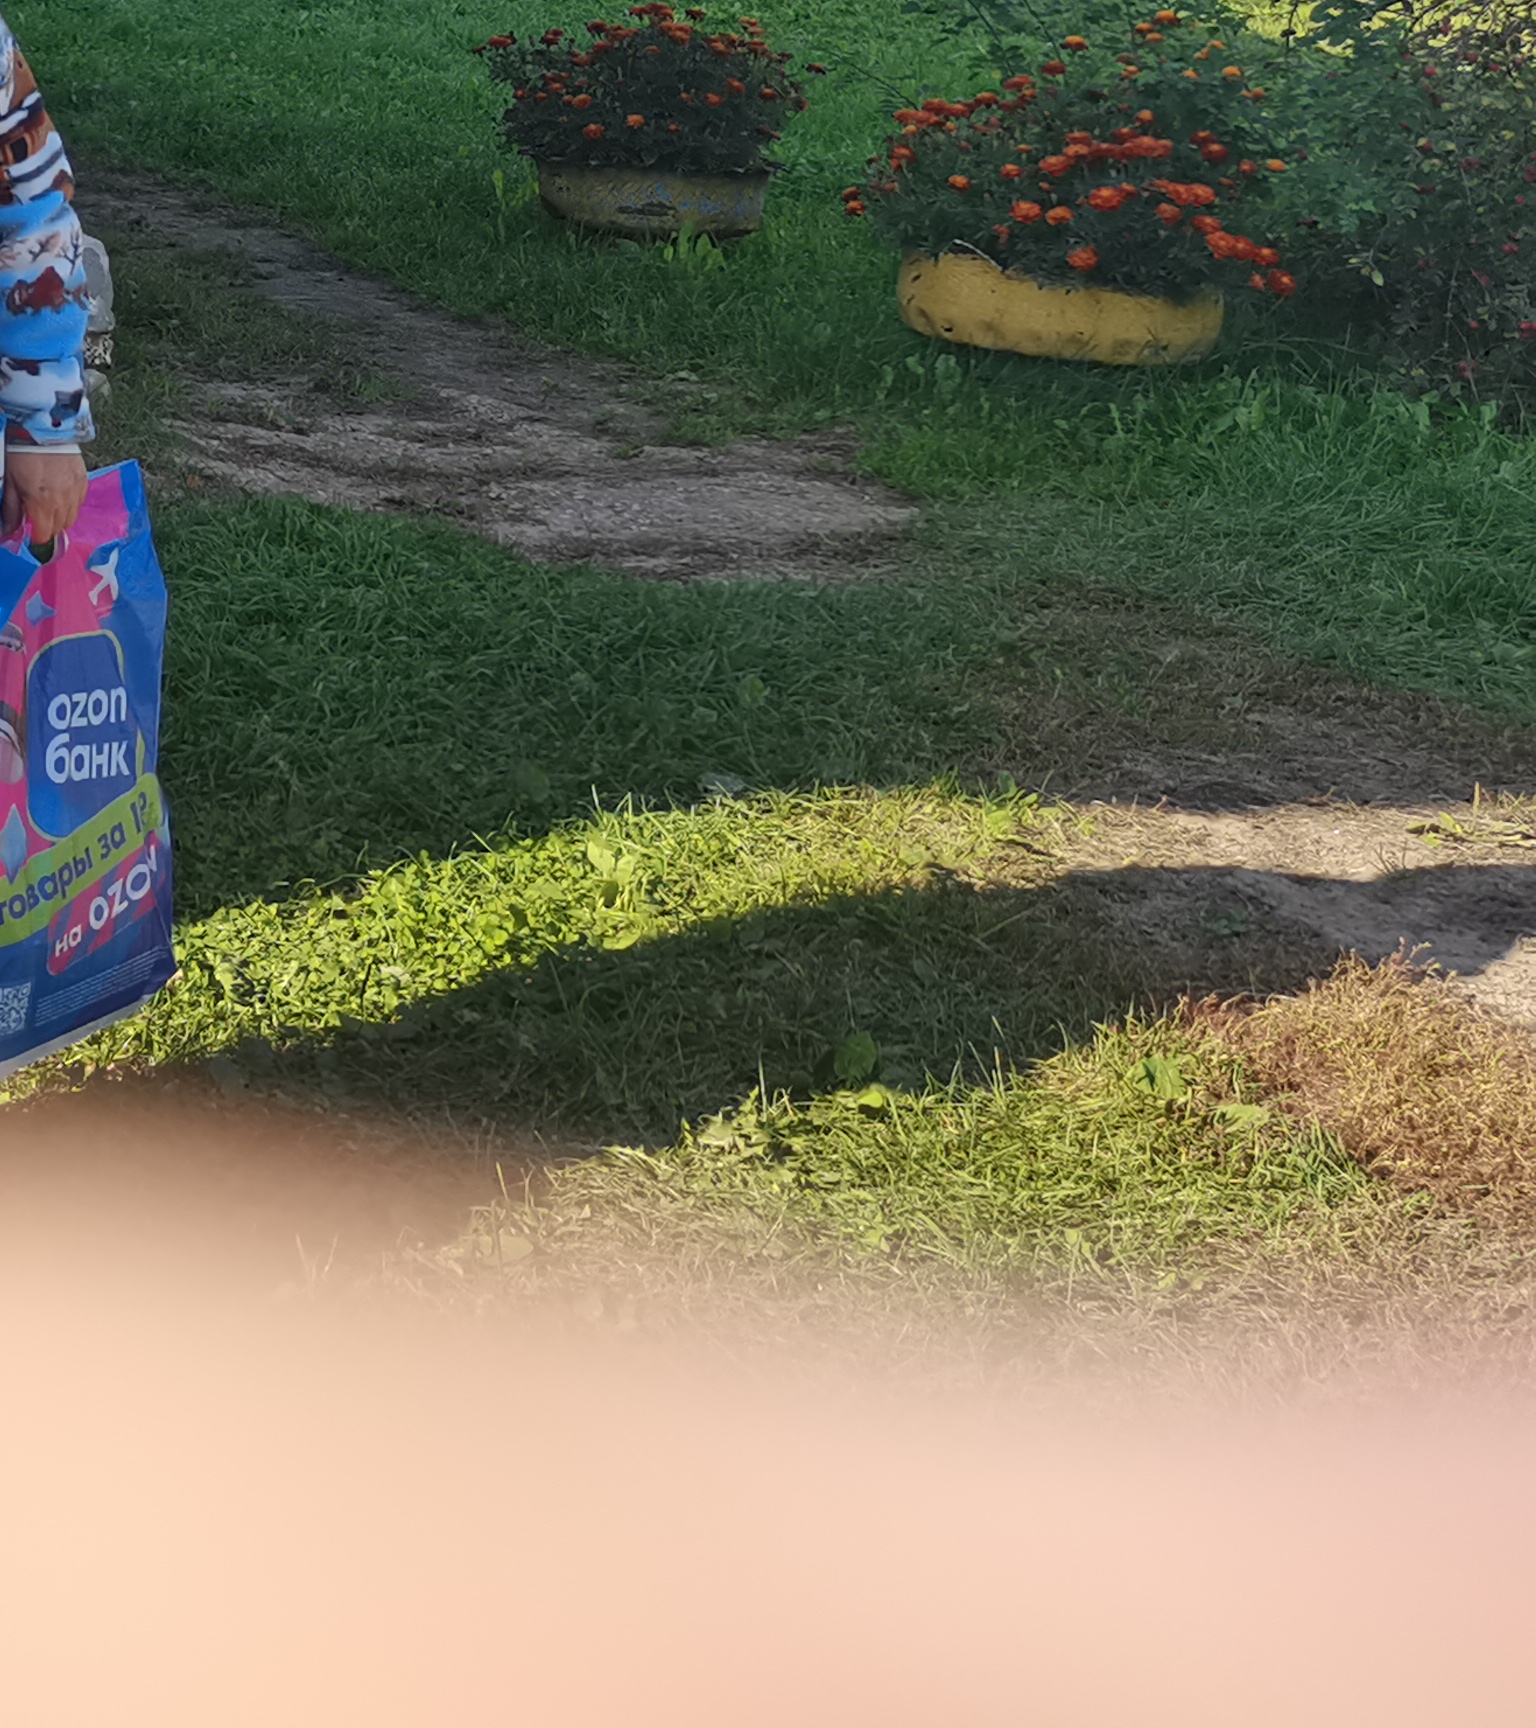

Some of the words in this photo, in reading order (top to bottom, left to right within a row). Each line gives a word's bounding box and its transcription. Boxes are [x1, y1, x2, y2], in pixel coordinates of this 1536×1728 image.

[45, 735, 130, 784] банк
[97, 822, 126, 860] за
[55, 925, 82, 957] на
